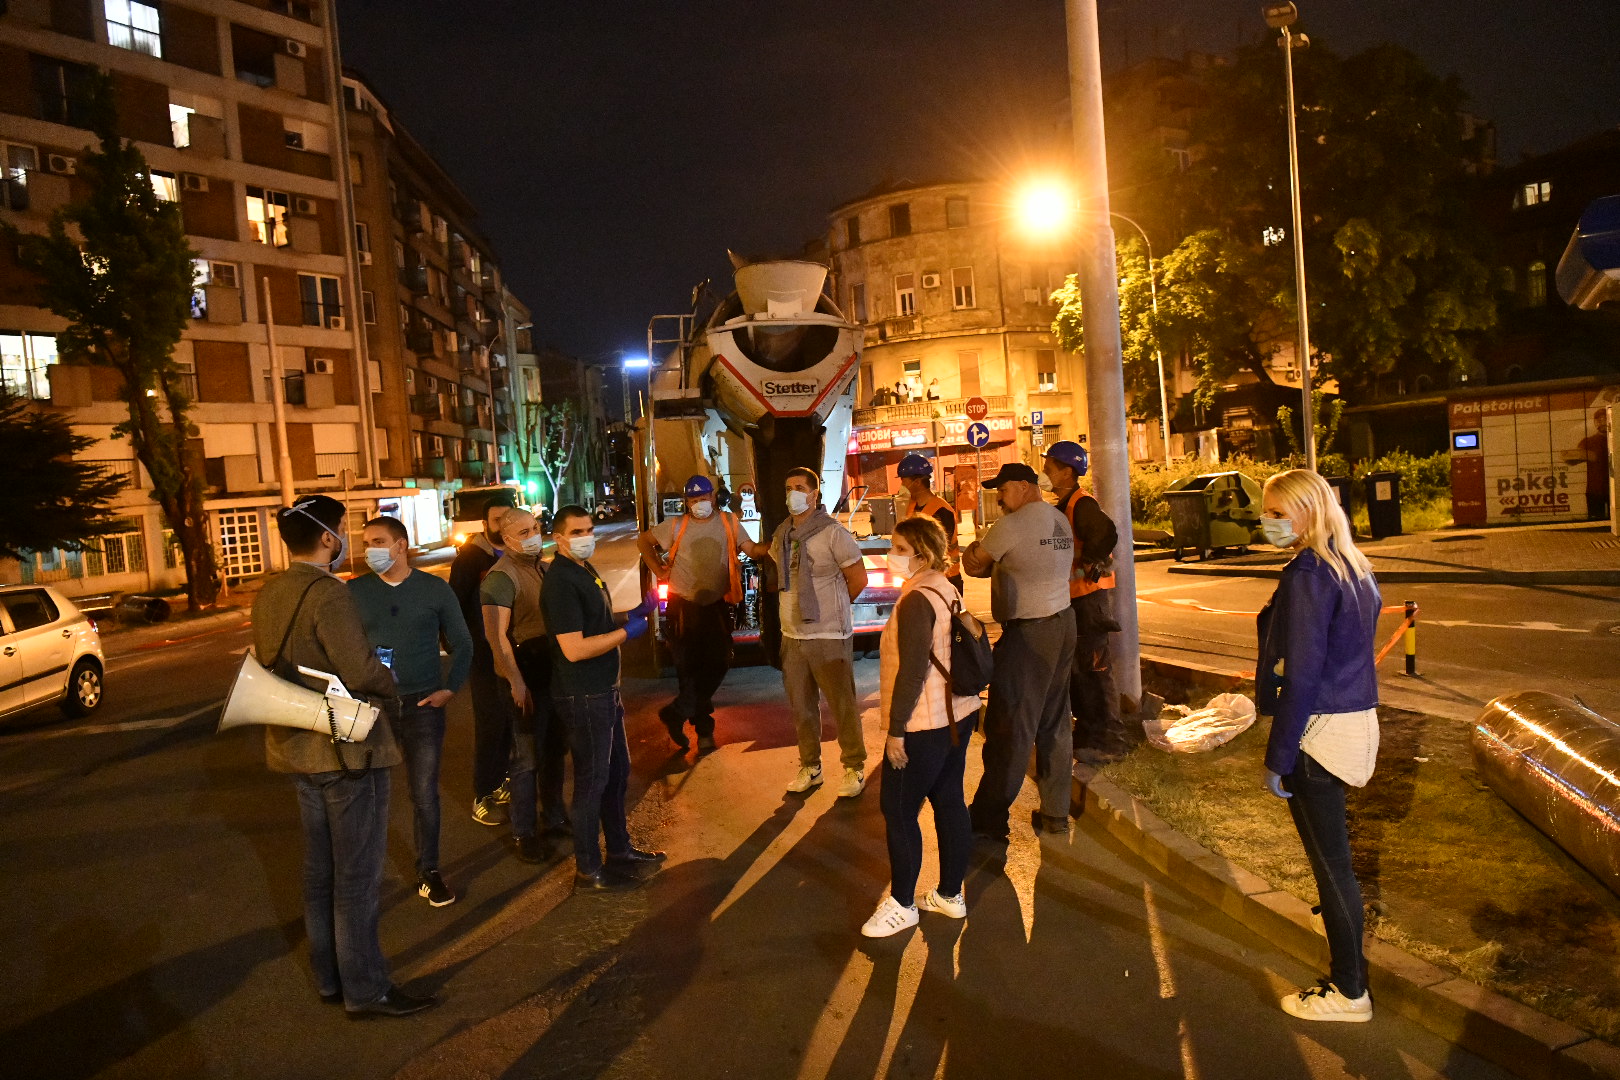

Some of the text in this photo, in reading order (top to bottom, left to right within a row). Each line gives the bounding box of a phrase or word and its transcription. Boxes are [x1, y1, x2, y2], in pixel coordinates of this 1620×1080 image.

[765, 382, 816, 394] Stetter
[967, 404, 986, 414] STOP
[1453, 396, 1542, 415] Paketomat
[1033, 412, 1041, 424] P
[1497, 472, 1568, 495] paket
[1518, 490, 1569, 506] ovde
[743, 509, 754, 518] 70
[1053, 543, 1071, 551] BAZA
